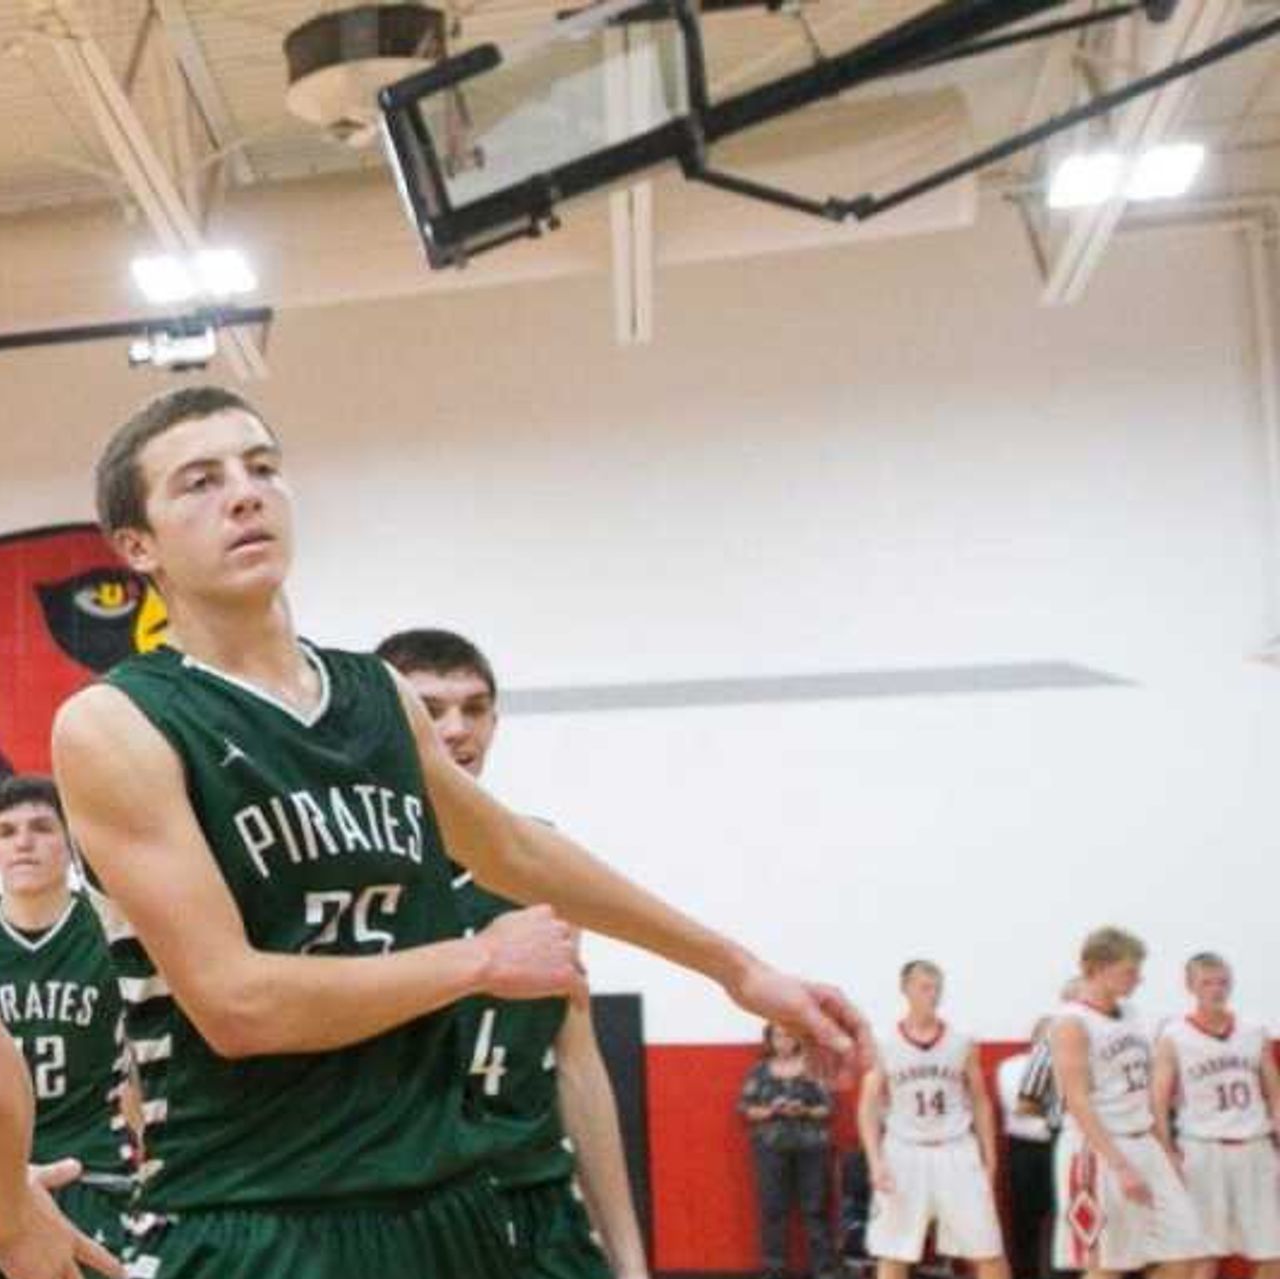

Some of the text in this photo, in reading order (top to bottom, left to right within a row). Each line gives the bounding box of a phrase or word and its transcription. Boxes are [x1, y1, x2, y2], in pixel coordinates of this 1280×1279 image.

[233, 784, 424, 878] PIRATES
[13, 1034, 67, 1099] 2
[469, 1008, 509, 1096] 4
[914, 1088, 947, 1118] 14
[1215, 1080, 1251, 1112] 10
